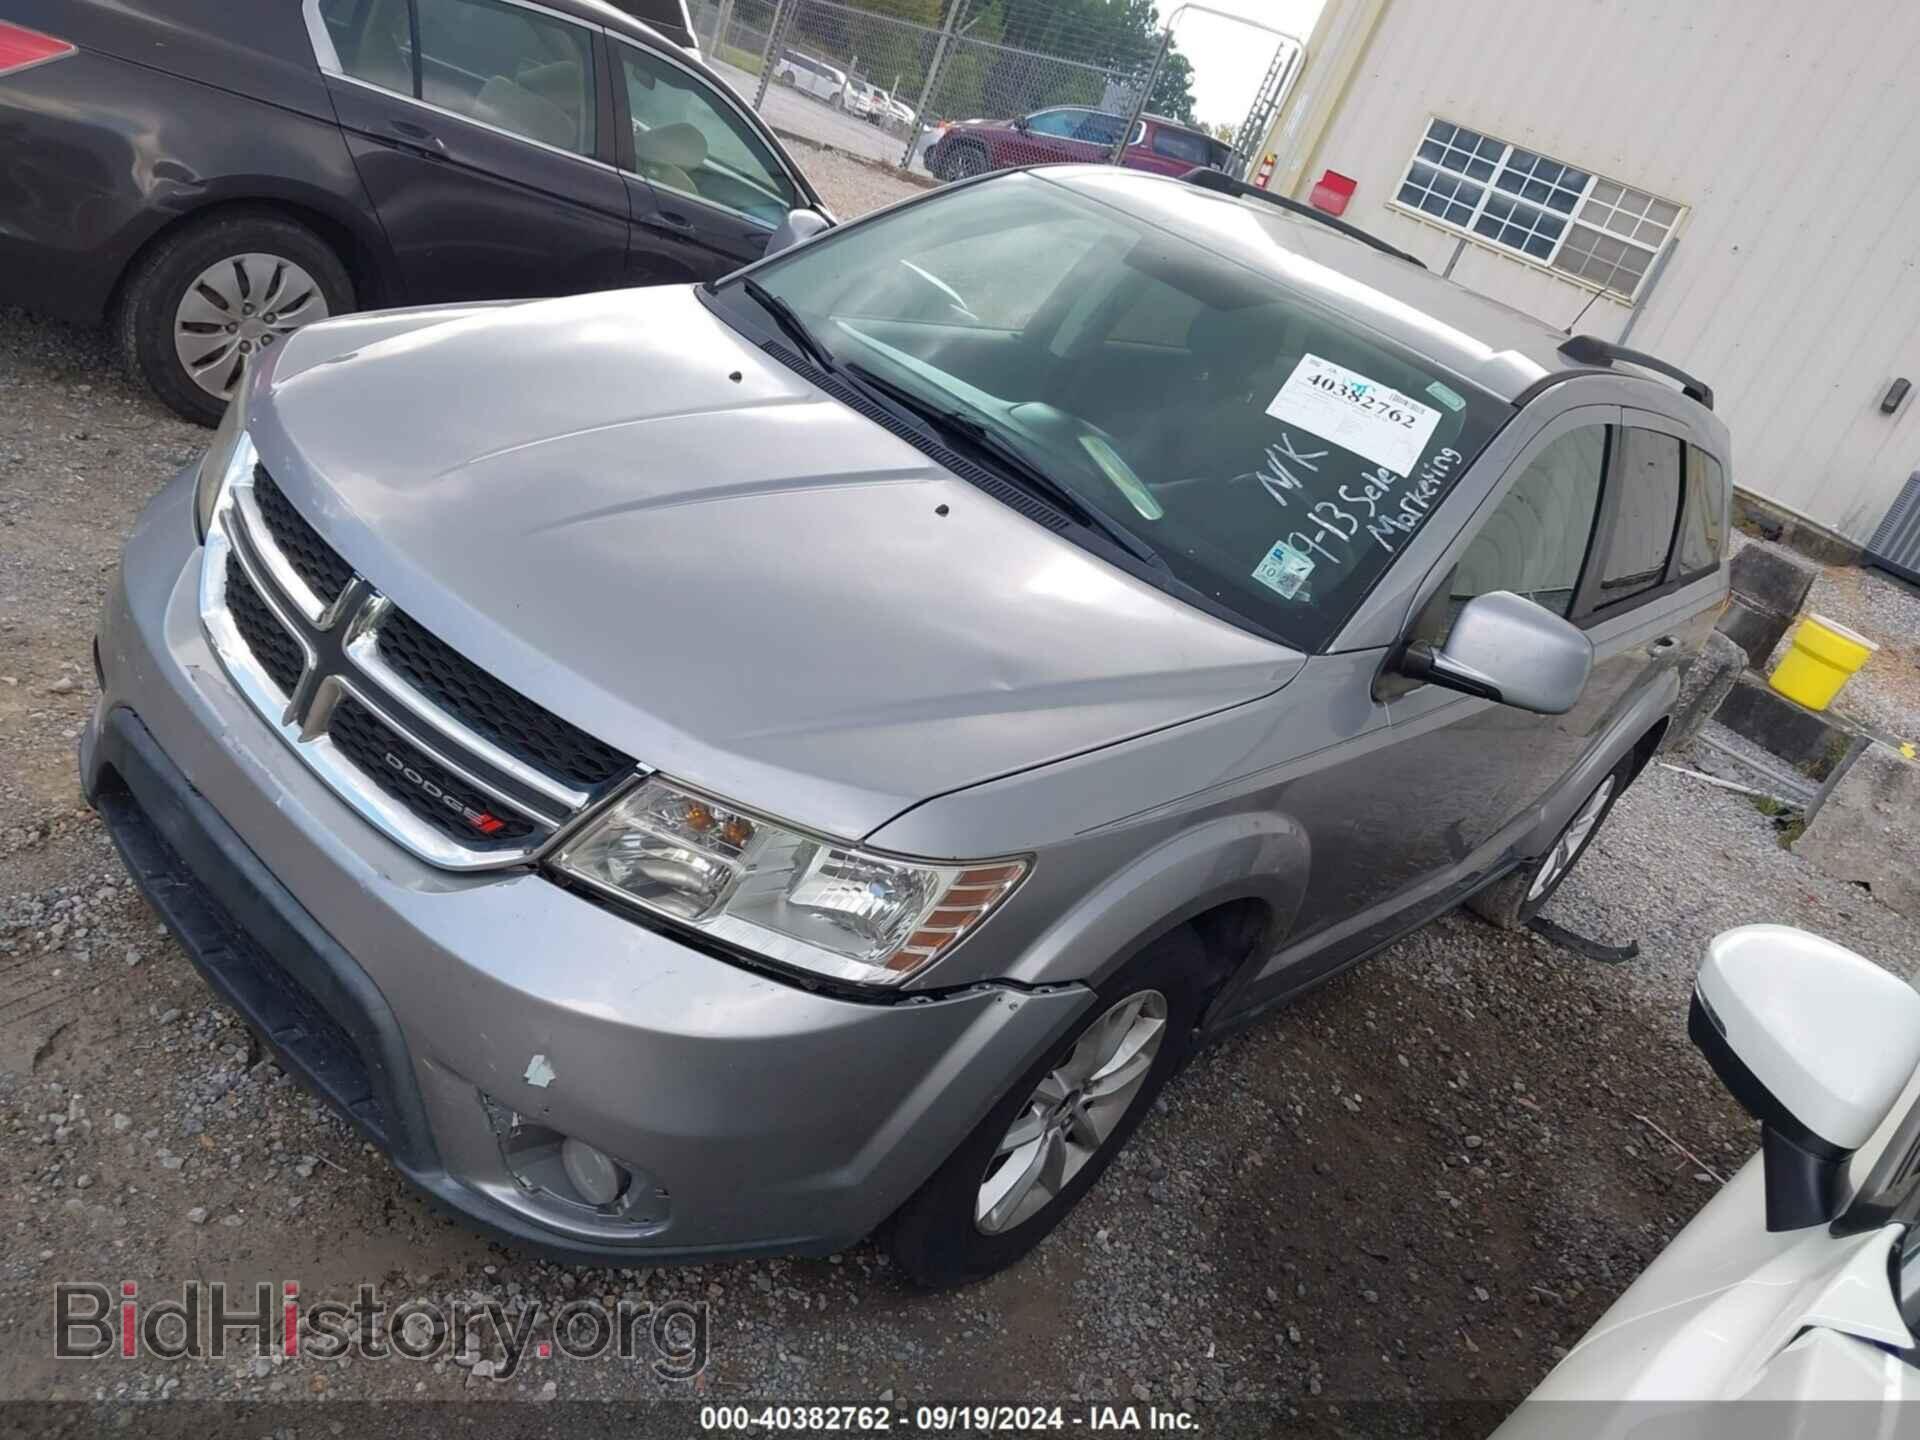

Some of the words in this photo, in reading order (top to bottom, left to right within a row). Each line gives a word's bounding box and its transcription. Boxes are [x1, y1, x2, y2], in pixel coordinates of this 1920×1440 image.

[1307, 374, 1416, 429] 40382762
[1288, 502, 1358, 564] 9-13
[1366, 447, 1462, 552] Marketing
[385, 752, 483, 825] DODGE
